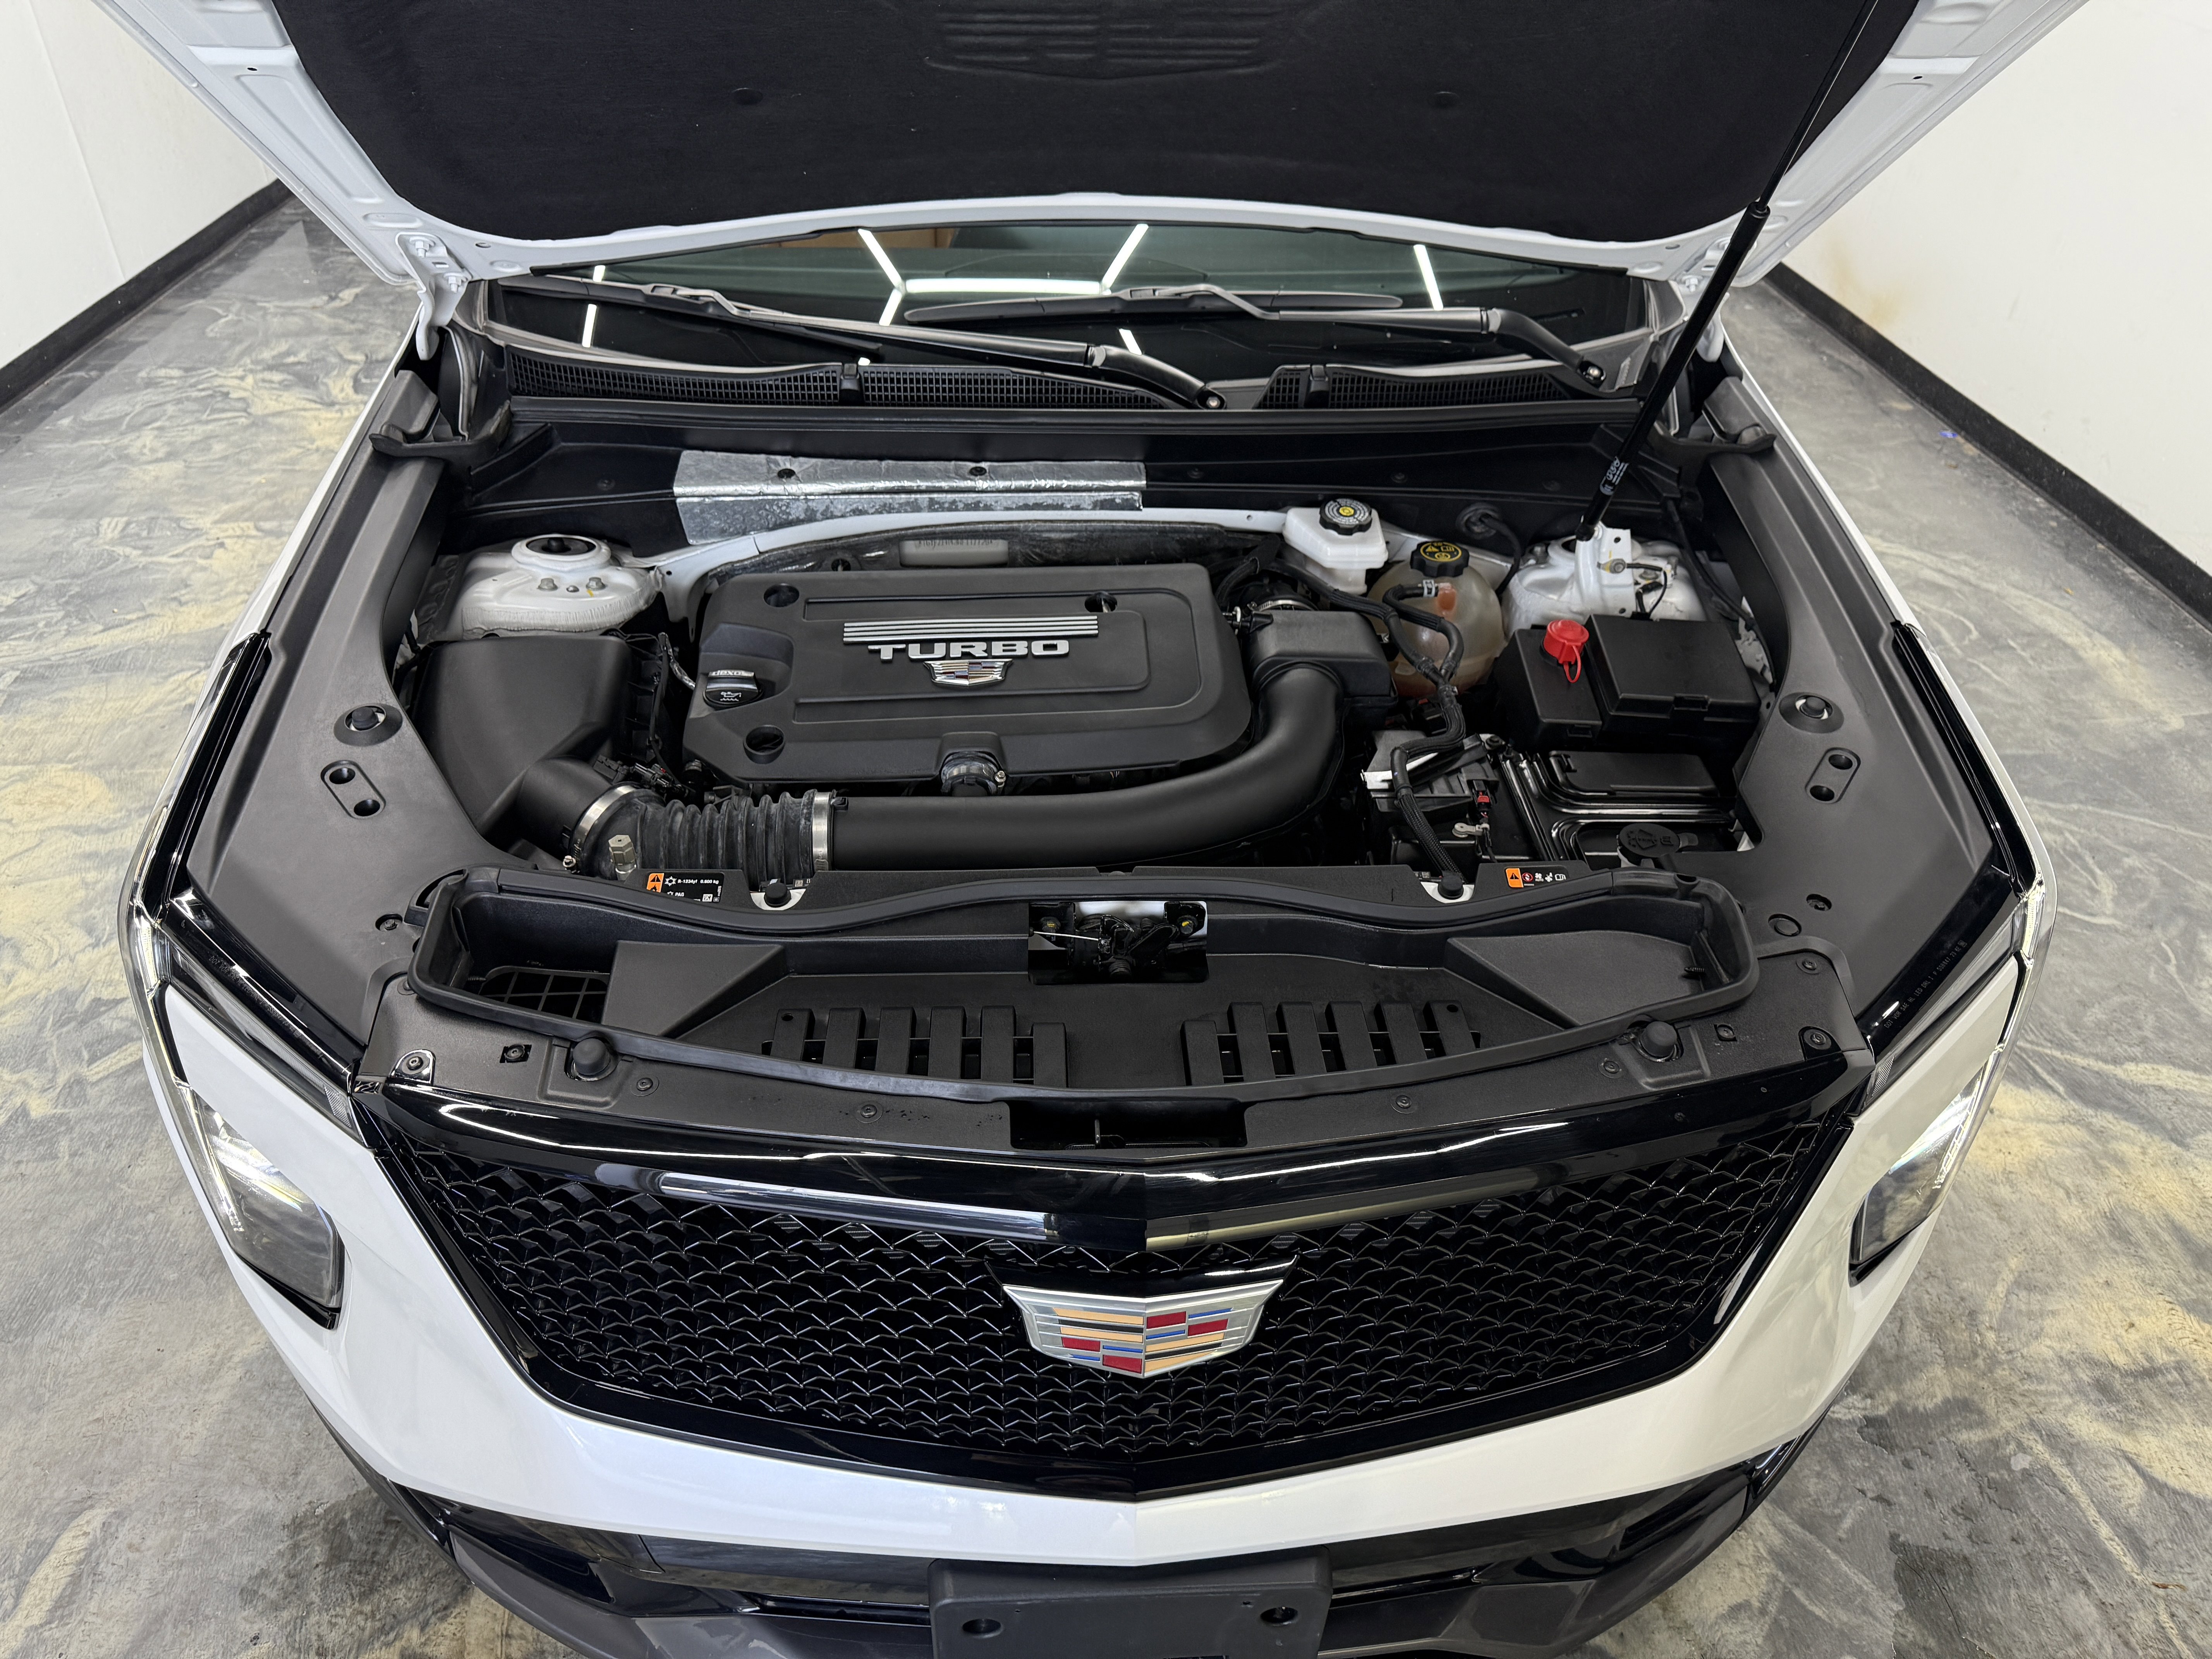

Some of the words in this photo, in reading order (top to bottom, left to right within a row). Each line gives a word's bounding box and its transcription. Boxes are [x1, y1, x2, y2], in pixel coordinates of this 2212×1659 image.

[868, 640, 1069, 660] TURBO
[1900, 1002, 1910, 1011] SAE
[1914, 988, 1923, 996] LED
